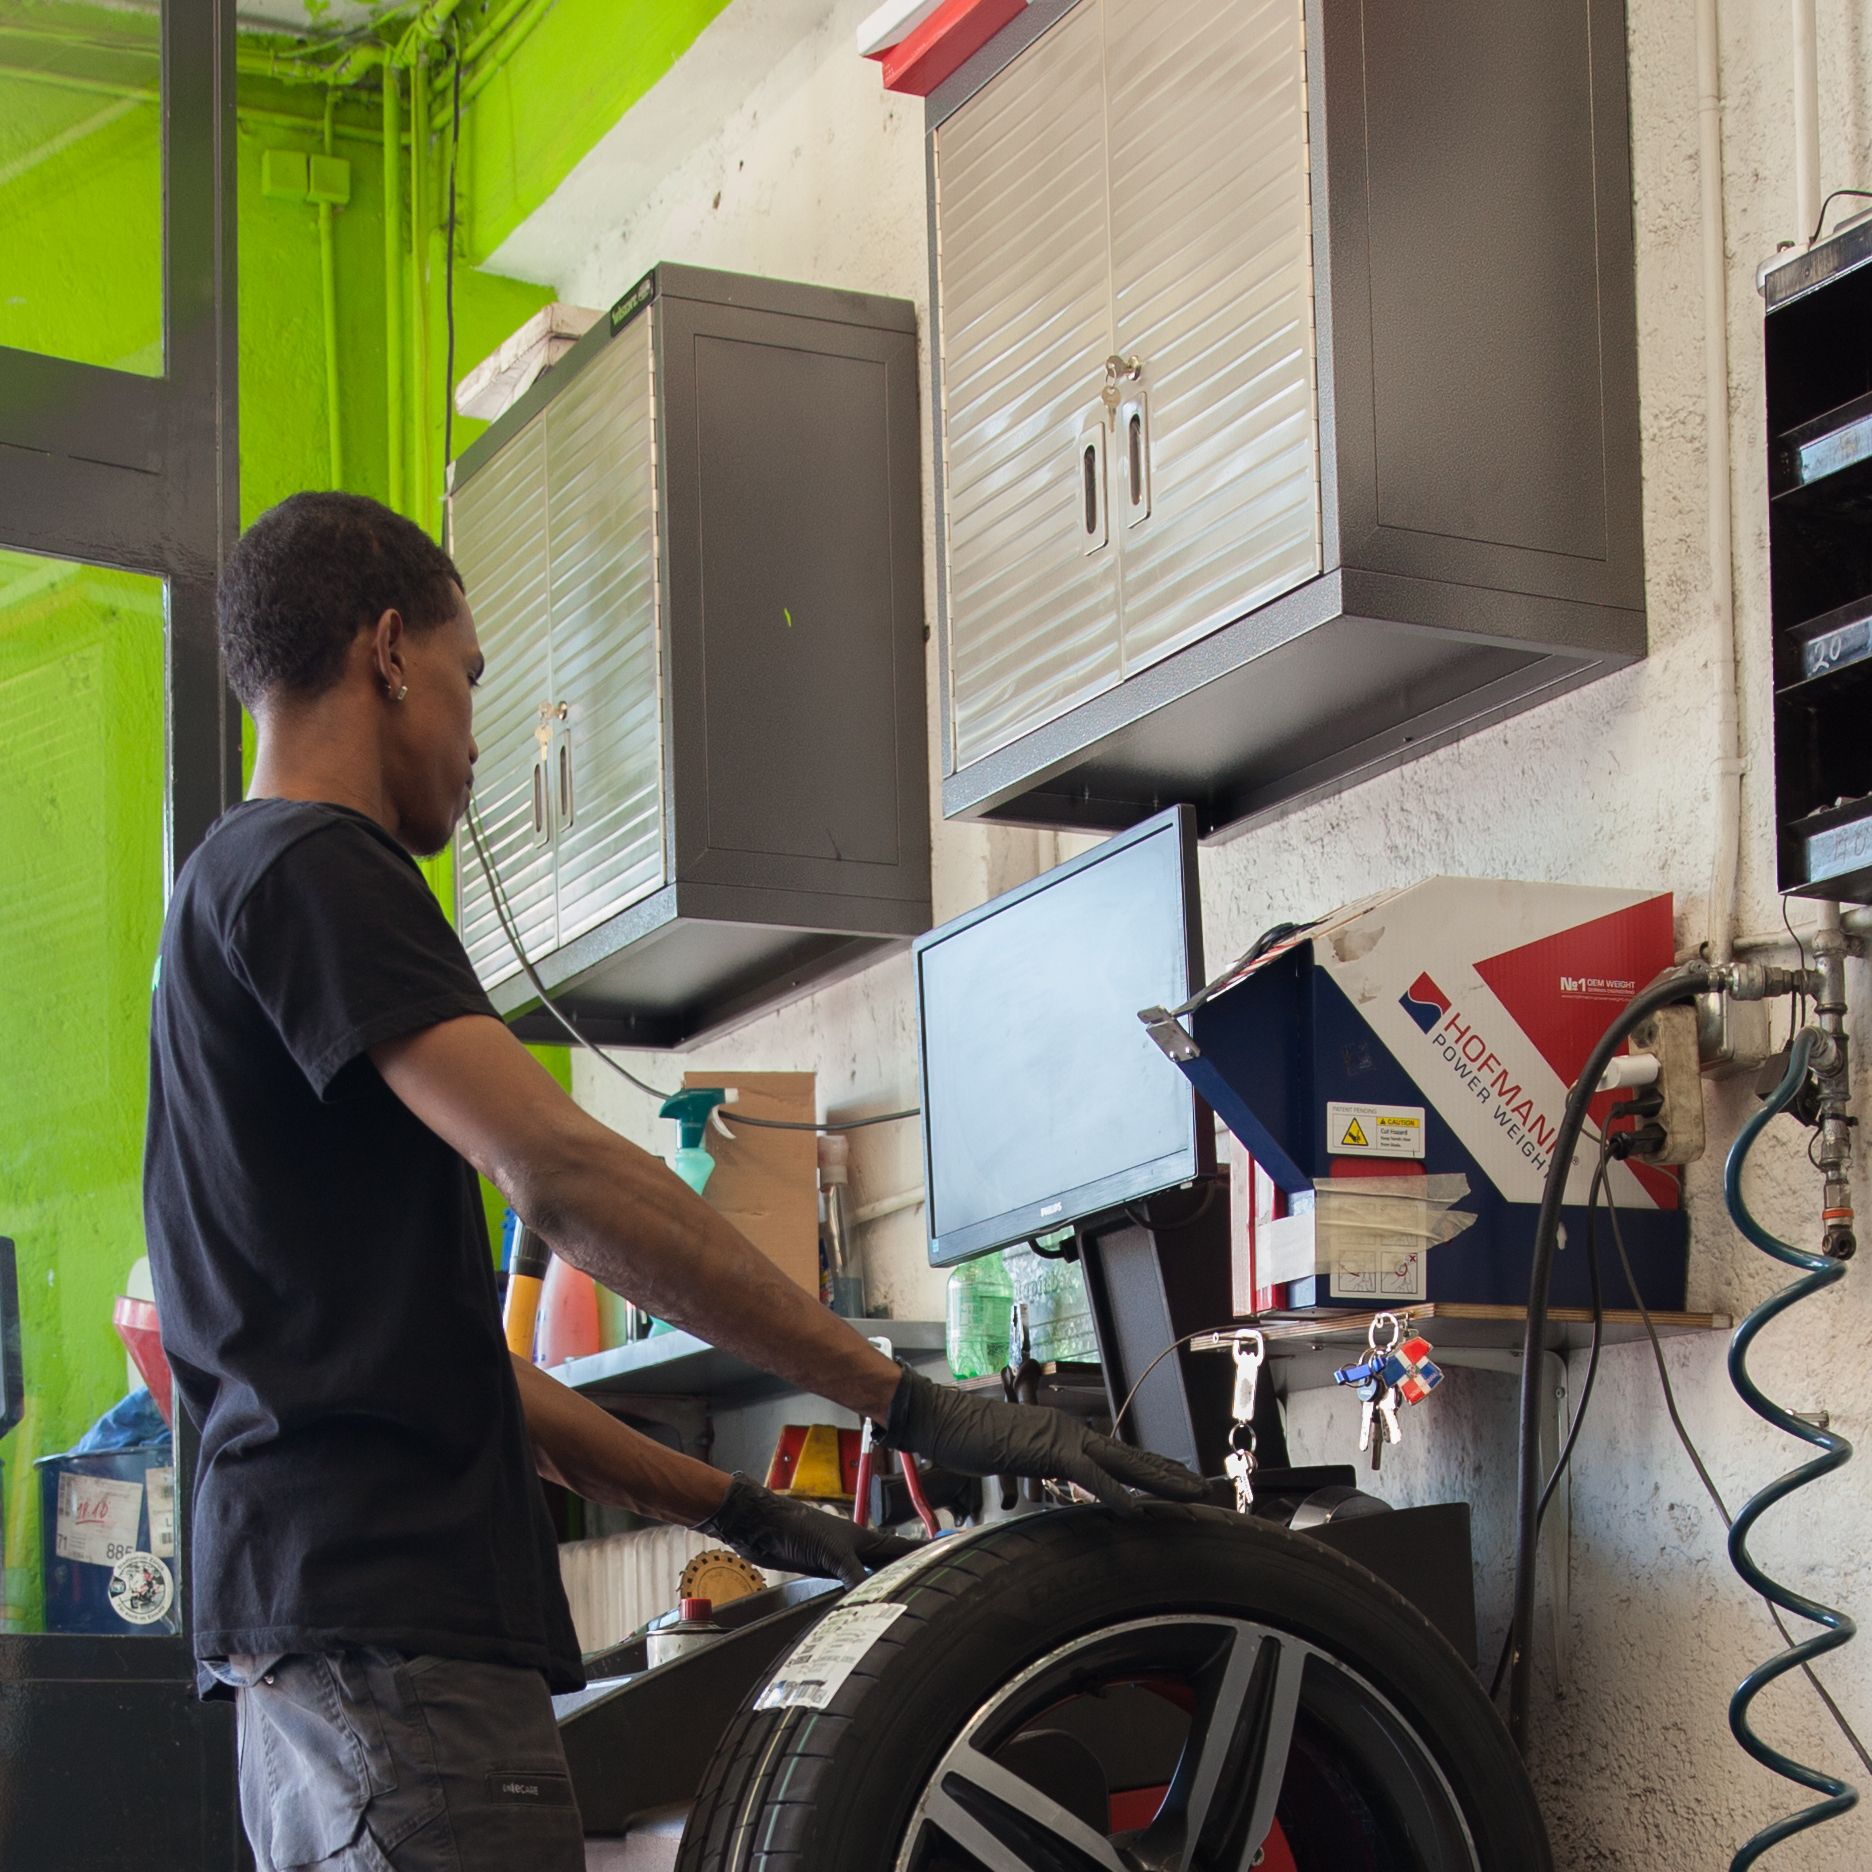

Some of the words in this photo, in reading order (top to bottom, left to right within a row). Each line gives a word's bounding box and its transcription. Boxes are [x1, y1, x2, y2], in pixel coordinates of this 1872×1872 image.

[1812, 636, 1841, 673] 20
[1606, 979, 1636, 989] WEIGHT
[1432, 1033, 1491, 1104] POWER
[1332, 1105, 1352, 1113] PATENT
[1388, 1118, 1414, 1126] CAUTION
